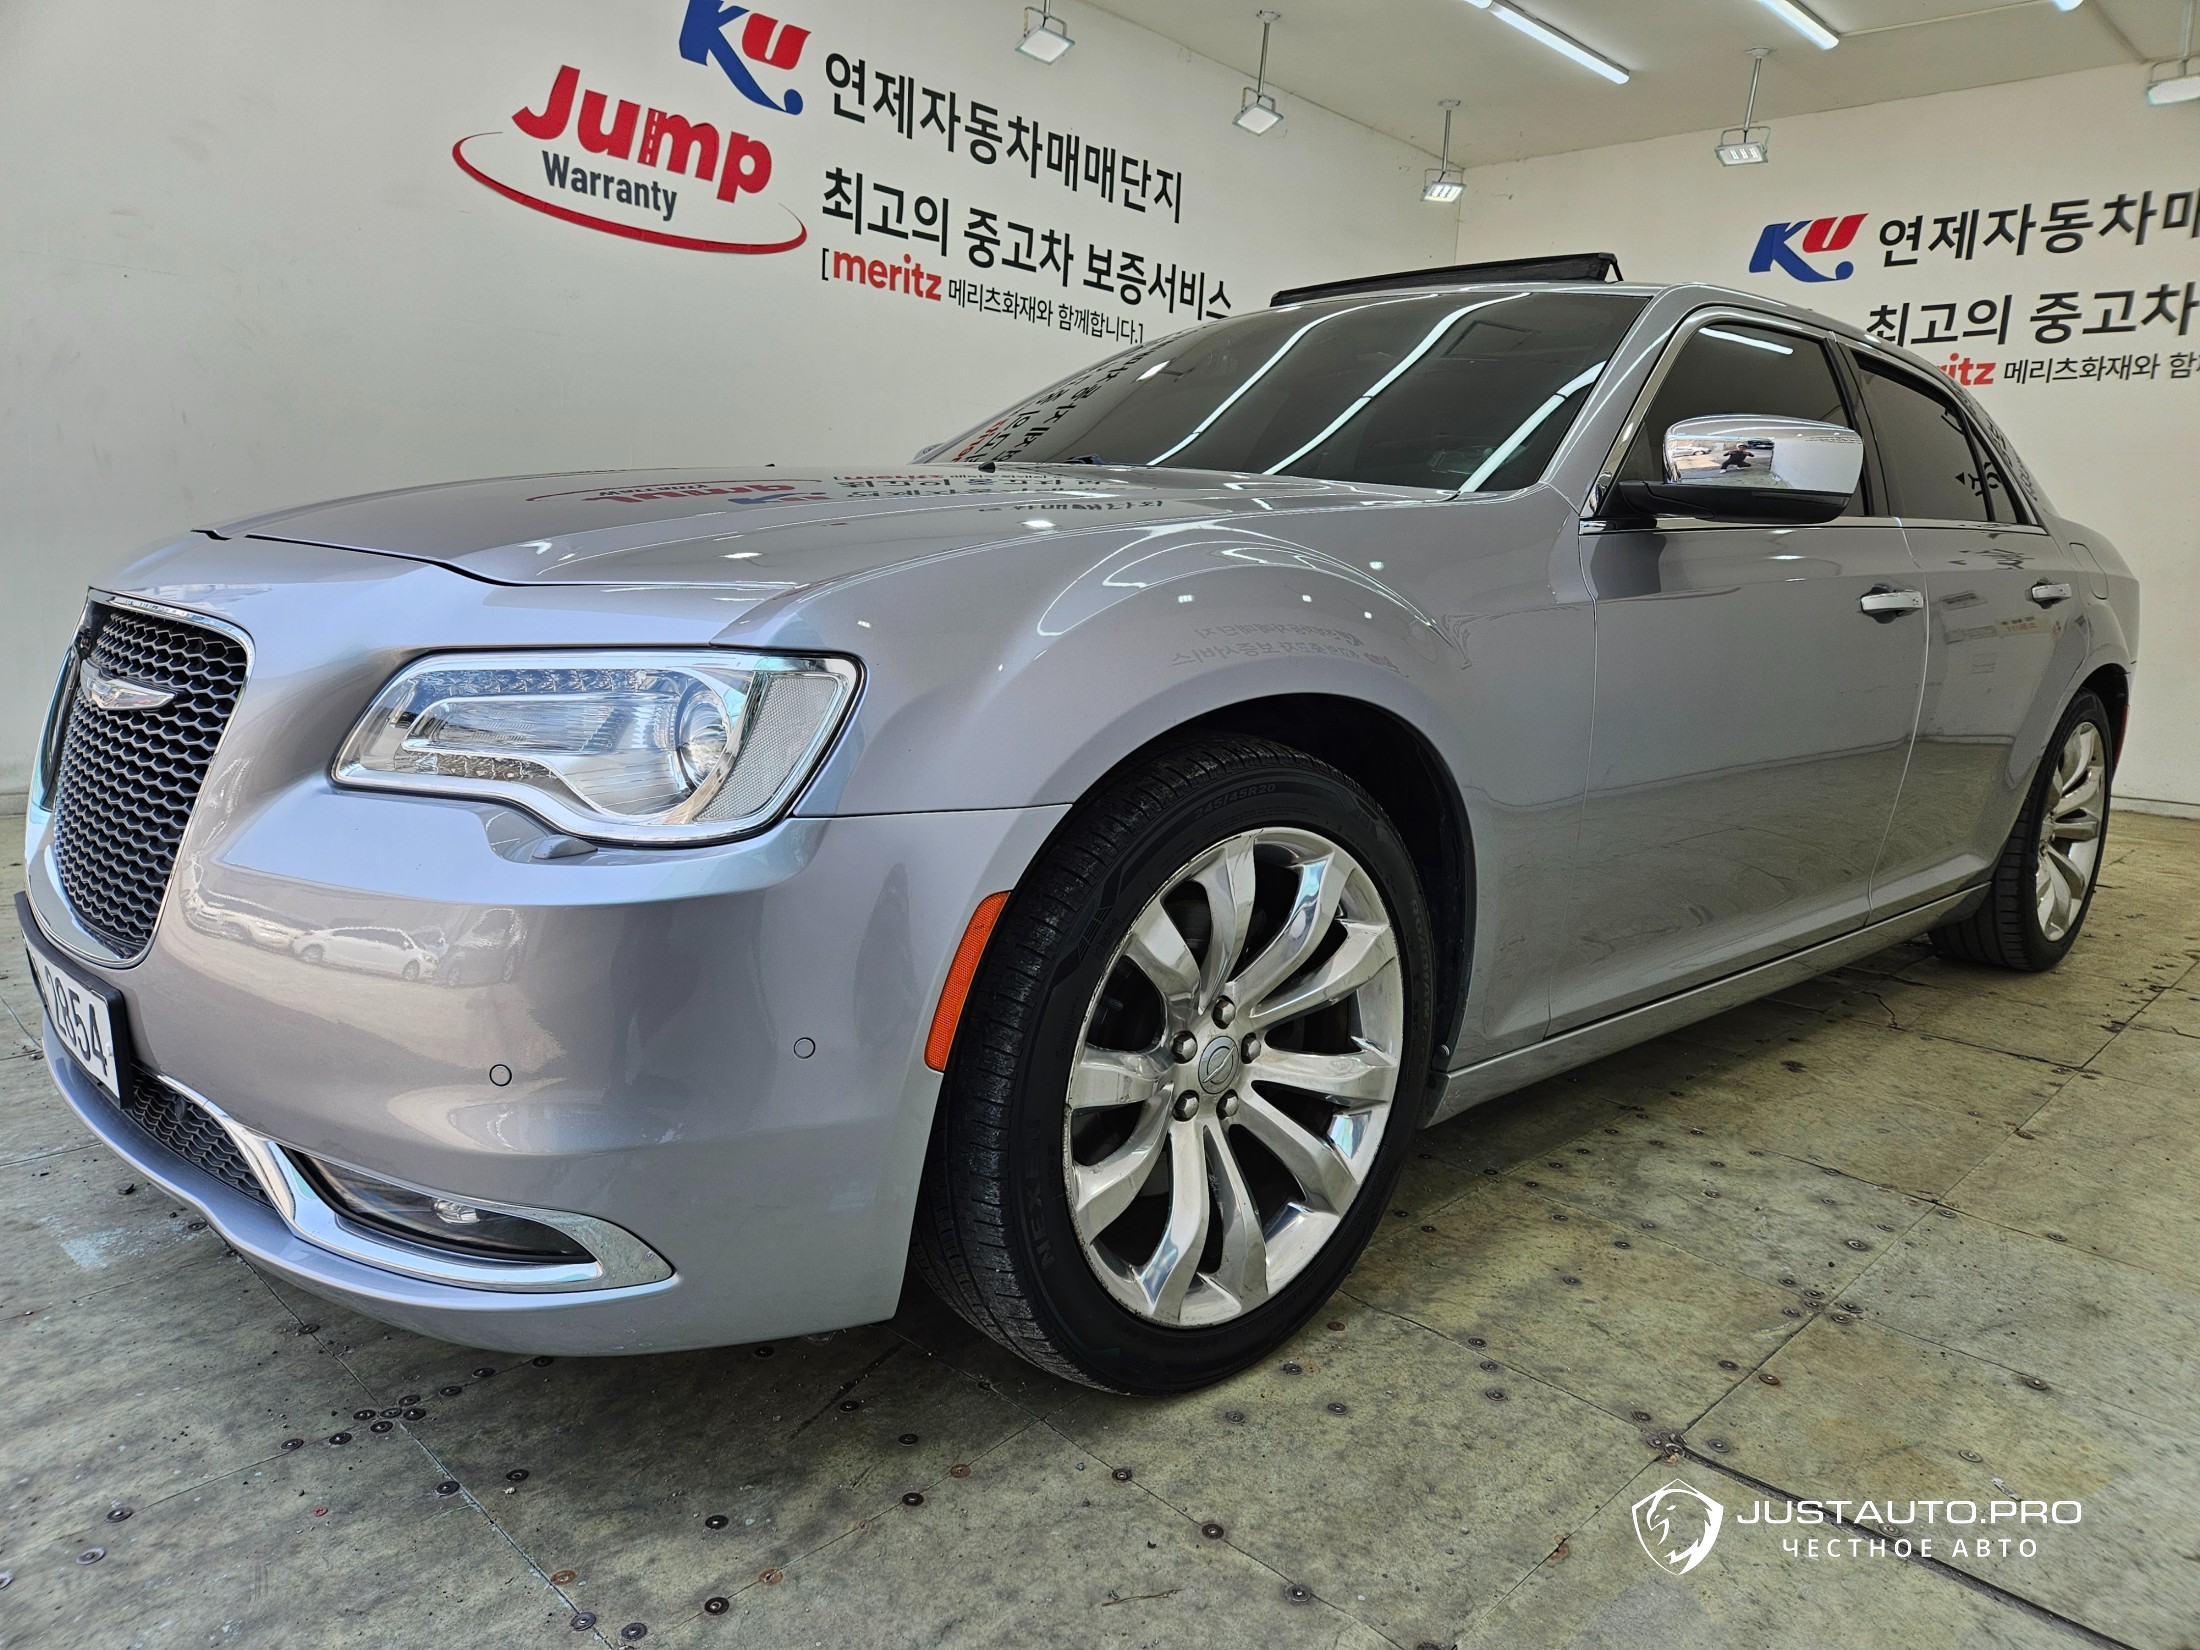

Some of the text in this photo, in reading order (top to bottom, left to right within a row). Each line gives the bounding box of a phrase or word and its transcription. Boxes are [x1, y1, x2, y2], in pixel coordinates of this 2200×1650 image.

[511, 65, 772, 203] Jump
[825, 53, 1183, 223] 연제자동차매매단지
[541, 150, 678, 222] Warranty
[822, 166, 1232, 320] 최고의 중고차 보증서비스
[948, 279, 1054, 327] 메리츠화재와
[1866, 281, 2200, 347] 최고의 중고차
[2003, 353, 2160, 385] 메리츠화재와
